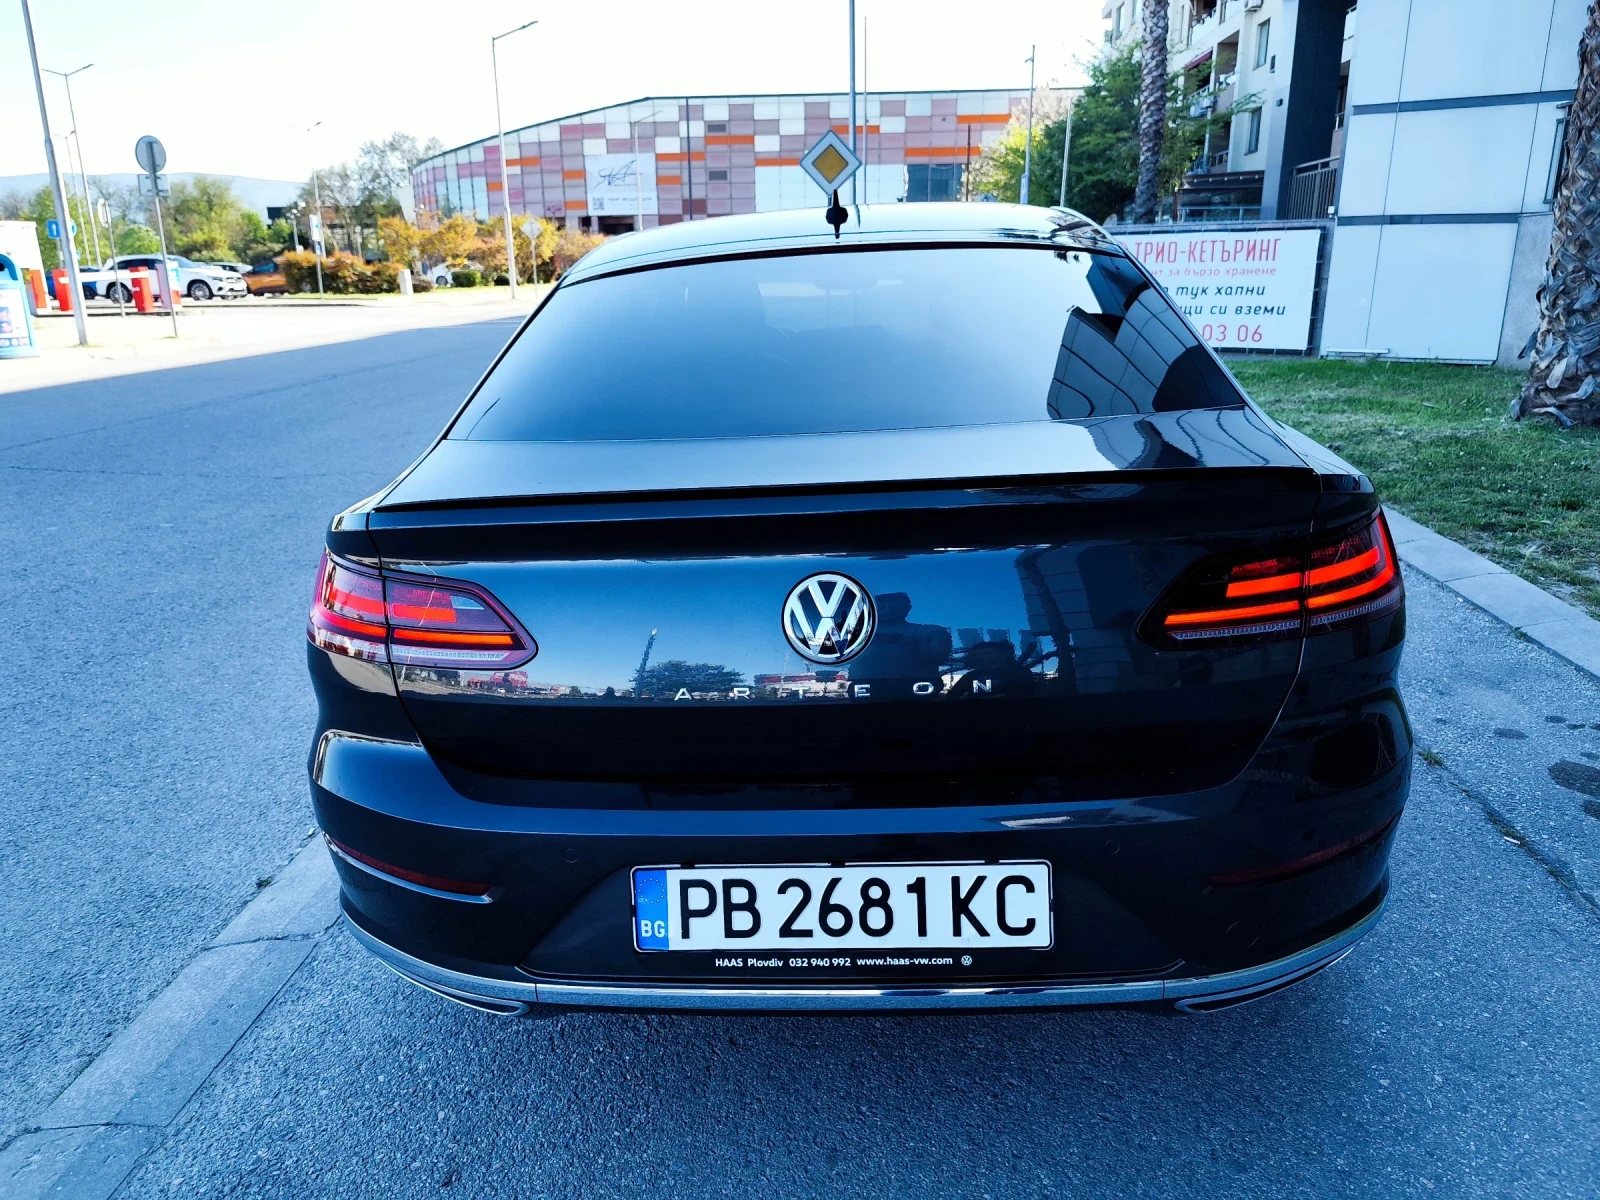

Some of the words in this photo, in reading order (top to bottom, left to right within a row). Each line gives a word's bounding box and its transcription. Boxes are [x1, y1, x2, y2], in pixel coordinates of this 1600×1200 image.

[1134, 238, 1281, 264] ТРИО-КЕТЪРИНГ
[1168, 269, 1180, 277] за
[1184, 267, 1220, 279] бързо
[1225, 267, 1277, 278] хранене
[1175, 285, 1209, 299] тук
[1214, 285, 1266, 296] хапни
[1210, 304, 1228, 315] си
[1234, 304, 1286, 316] вземи
[1237, 323, 1263, 343] 06
[640, 919, 666, 938] BG
[679, 878, 762, 940] PB
[777, 876, 928, 939] 2681
[951, 875, 1036, 938] KC
[715, 957, 744, 967] HAAS
[747, 956, 784, 967] Plovdiv
[788, 956, 809, 967] 032
[810, 956, 830, 967] 940
[831, 956, 852, 967] 992
[856, 955, 953, 966] www.haas-vw.com
